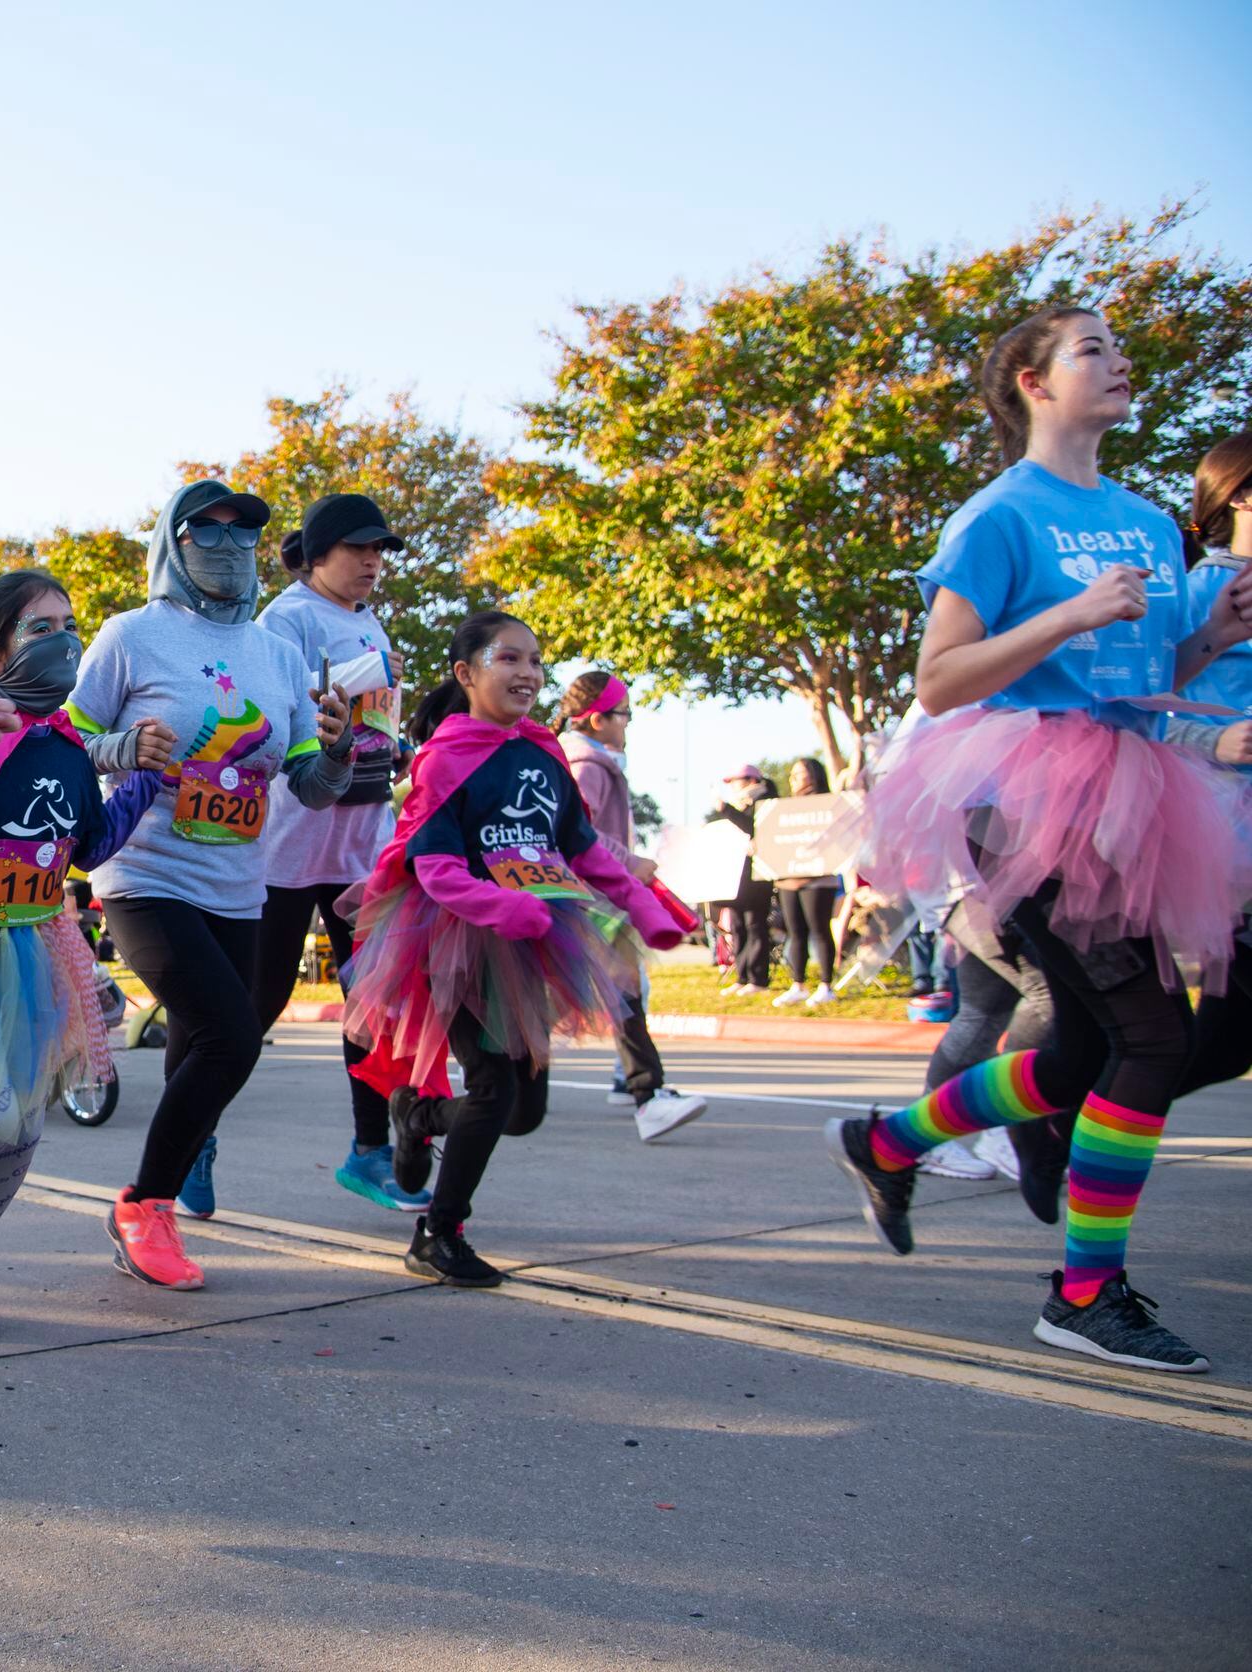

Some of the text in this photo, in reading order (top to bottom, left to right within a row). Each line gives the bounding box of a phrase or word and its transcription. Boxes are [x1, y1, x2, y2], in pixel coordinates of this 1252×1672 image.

[1048, 526, 1155, 553] heart
[189, 790, 259, 827] 1620
[480, 822, 548, 846] Girls on
